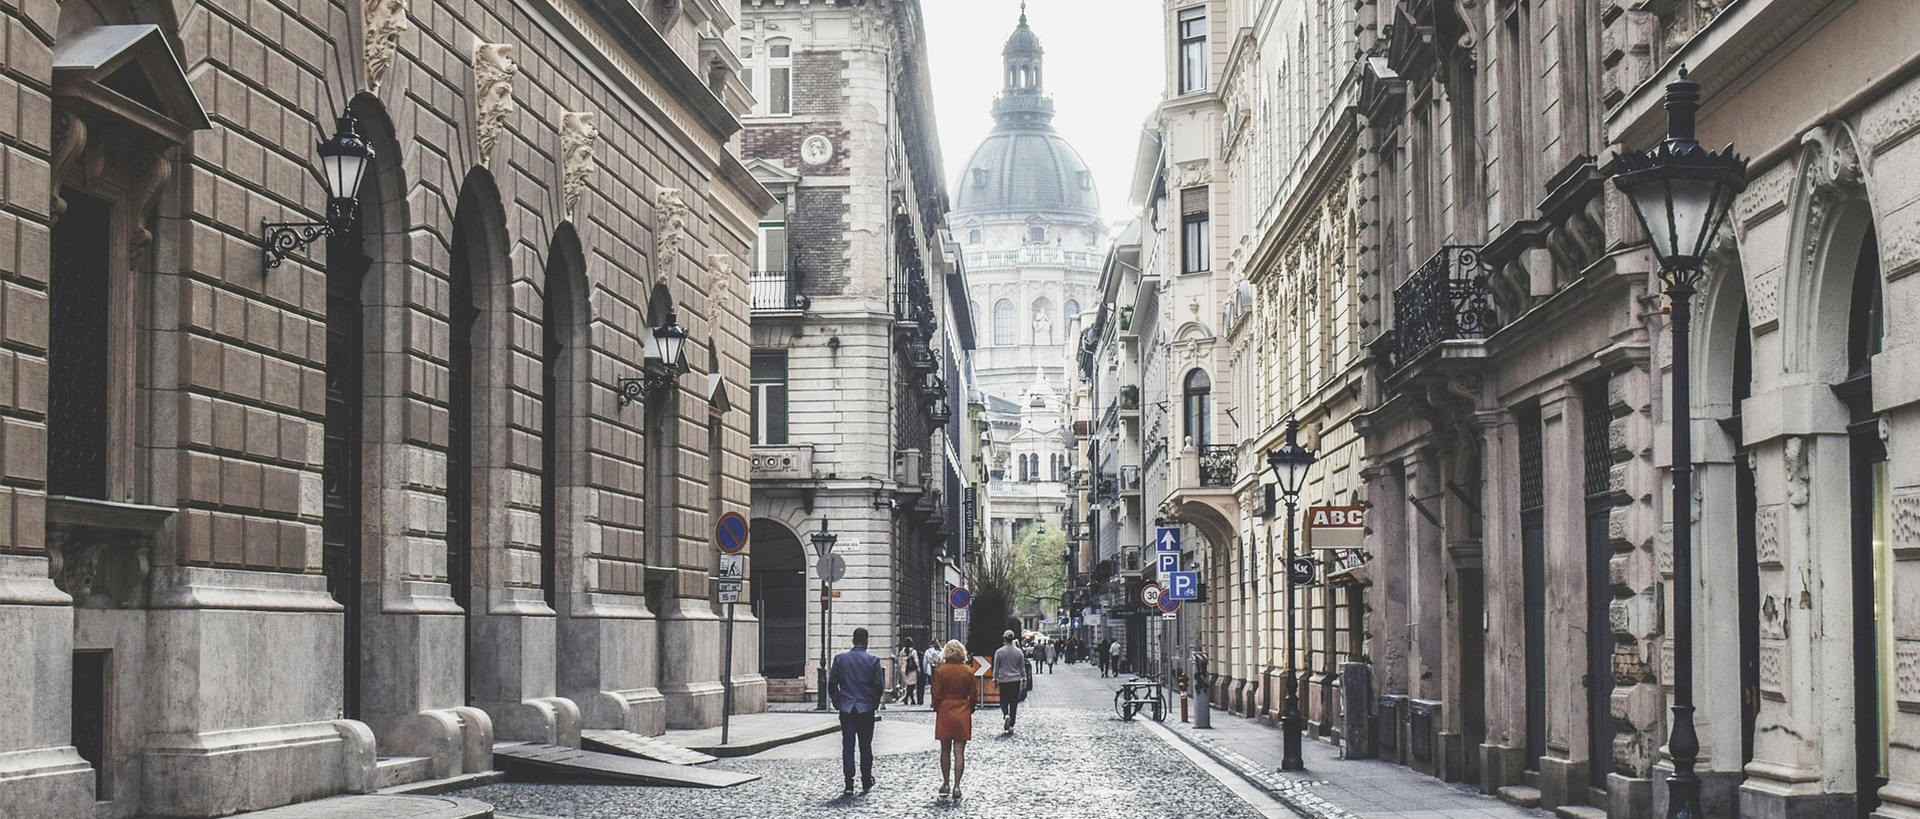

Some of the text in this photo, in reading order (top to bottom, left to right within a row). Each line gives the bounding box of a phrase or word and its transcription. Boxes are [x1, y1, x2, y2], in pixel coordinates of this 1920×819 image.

[965, 488, 973, 502] Inn
[965, 503, 973, 530] Garden
[1313, 510, 1363, 525] ABC
[1163, 556, 1174, 571] P
[1176, 575, 1191, 596] P
[722, 593, 729, 601] 15
[1147, 591, 1158, 600] 30
